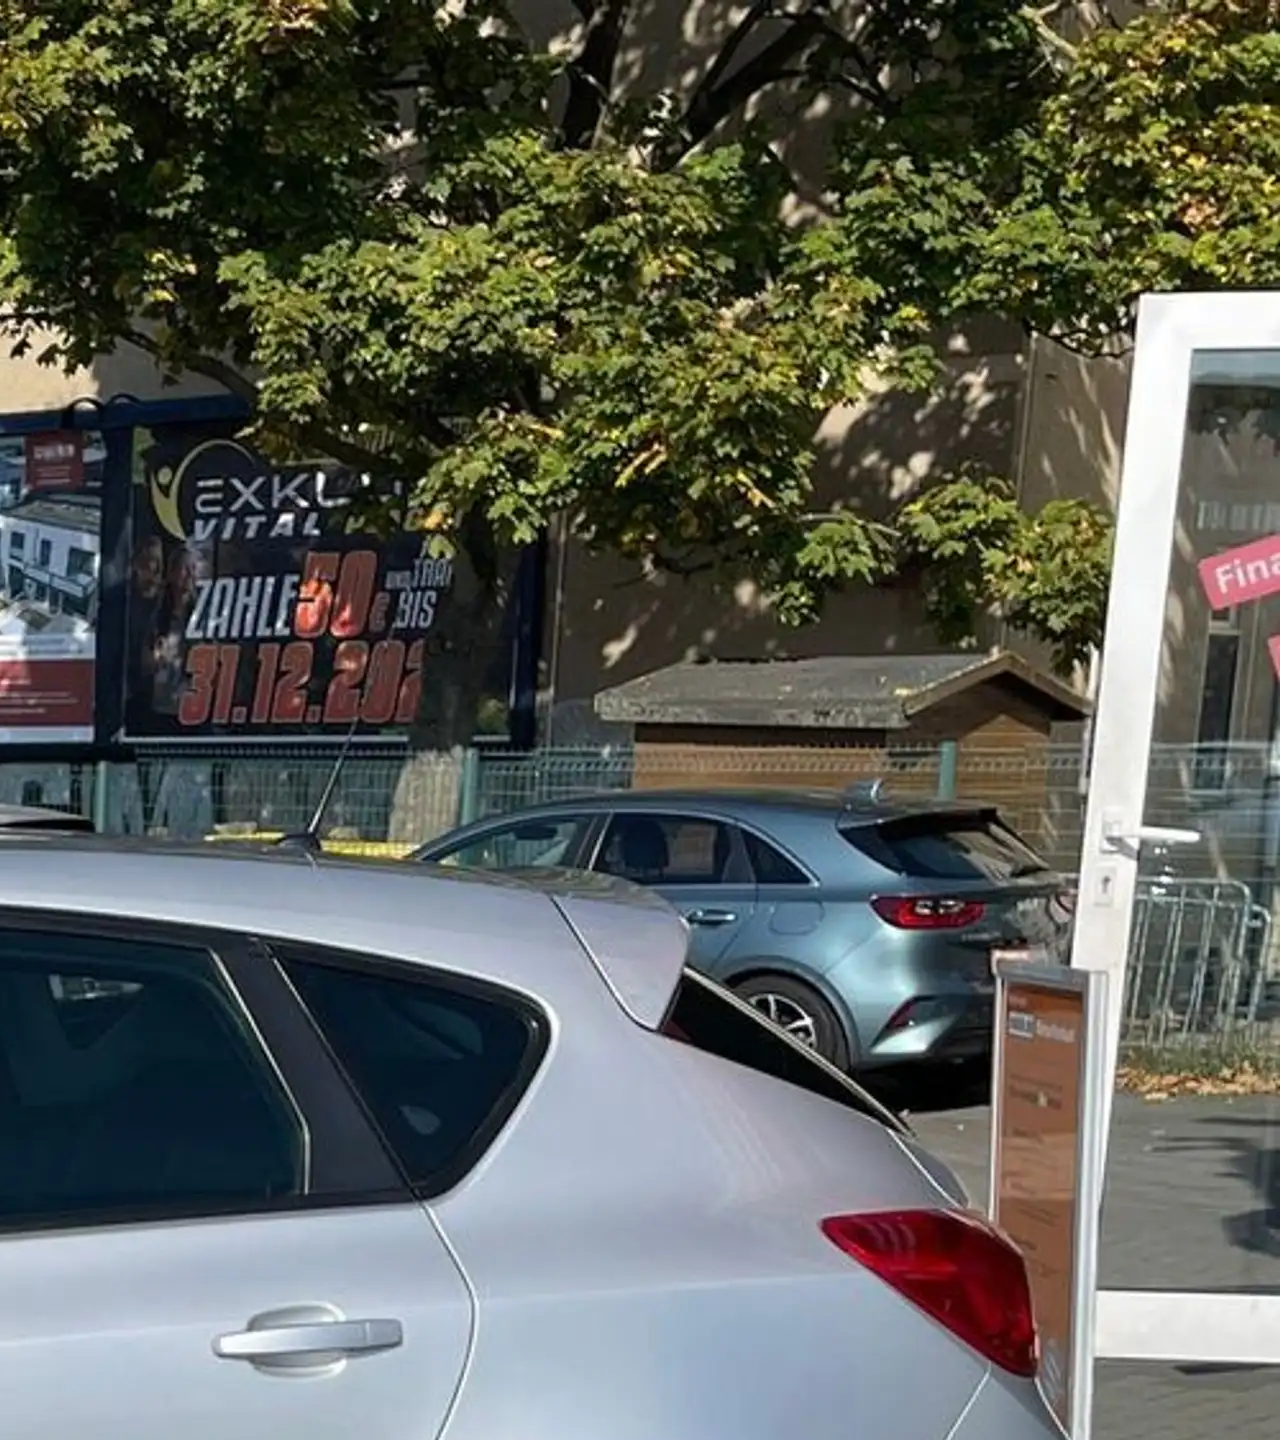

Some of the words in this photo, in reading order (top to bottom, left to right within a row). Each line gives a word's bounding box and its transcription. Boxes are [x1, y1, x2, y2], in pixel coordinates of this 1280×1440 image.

[194, 511, 321, 541] VITAL
[185, 574, 300, 639] ZAHLE
[394, 590, 437, 629] BIS
